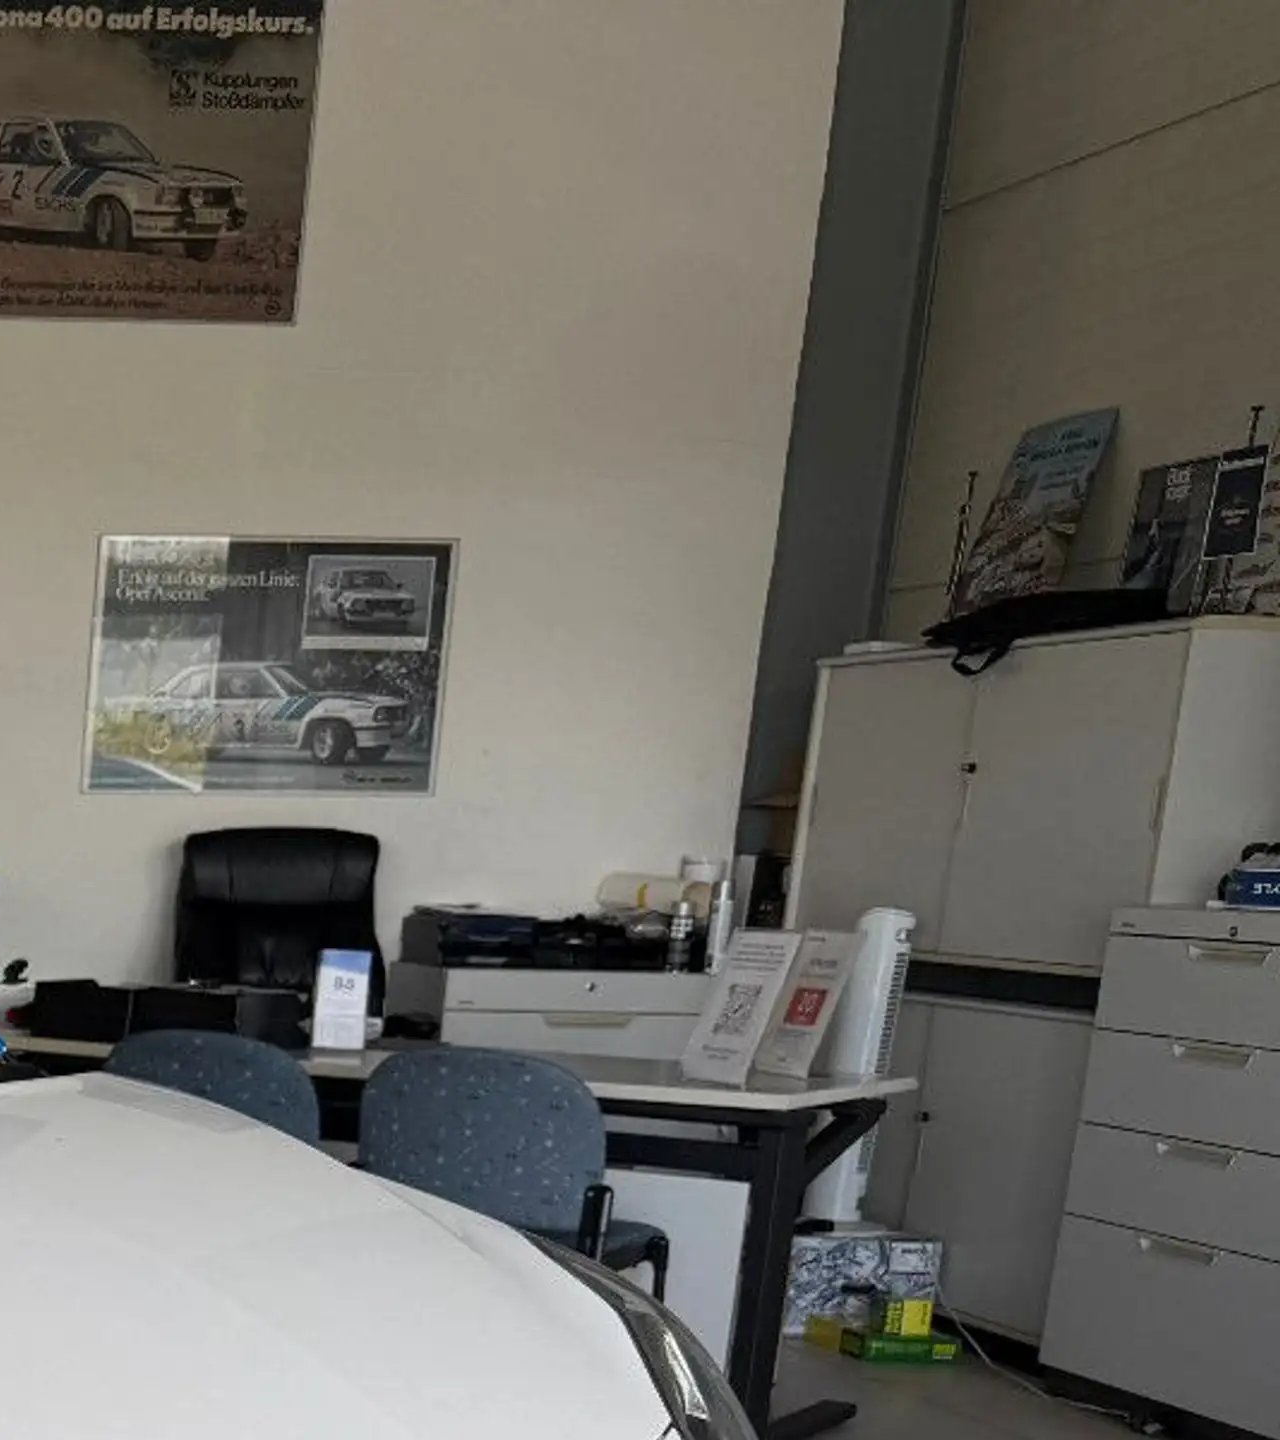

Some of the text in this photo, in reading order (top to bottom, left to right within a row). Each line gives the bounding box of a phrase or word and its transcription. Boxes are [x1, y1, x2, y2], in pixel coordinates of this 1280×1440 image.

[44, 7, 103, 30] 400
[107, 8, 153, 31] auf
[155, 9, 314, 38] Erfolgskurs.
[204, 71, 298, 92] Kupplungen
